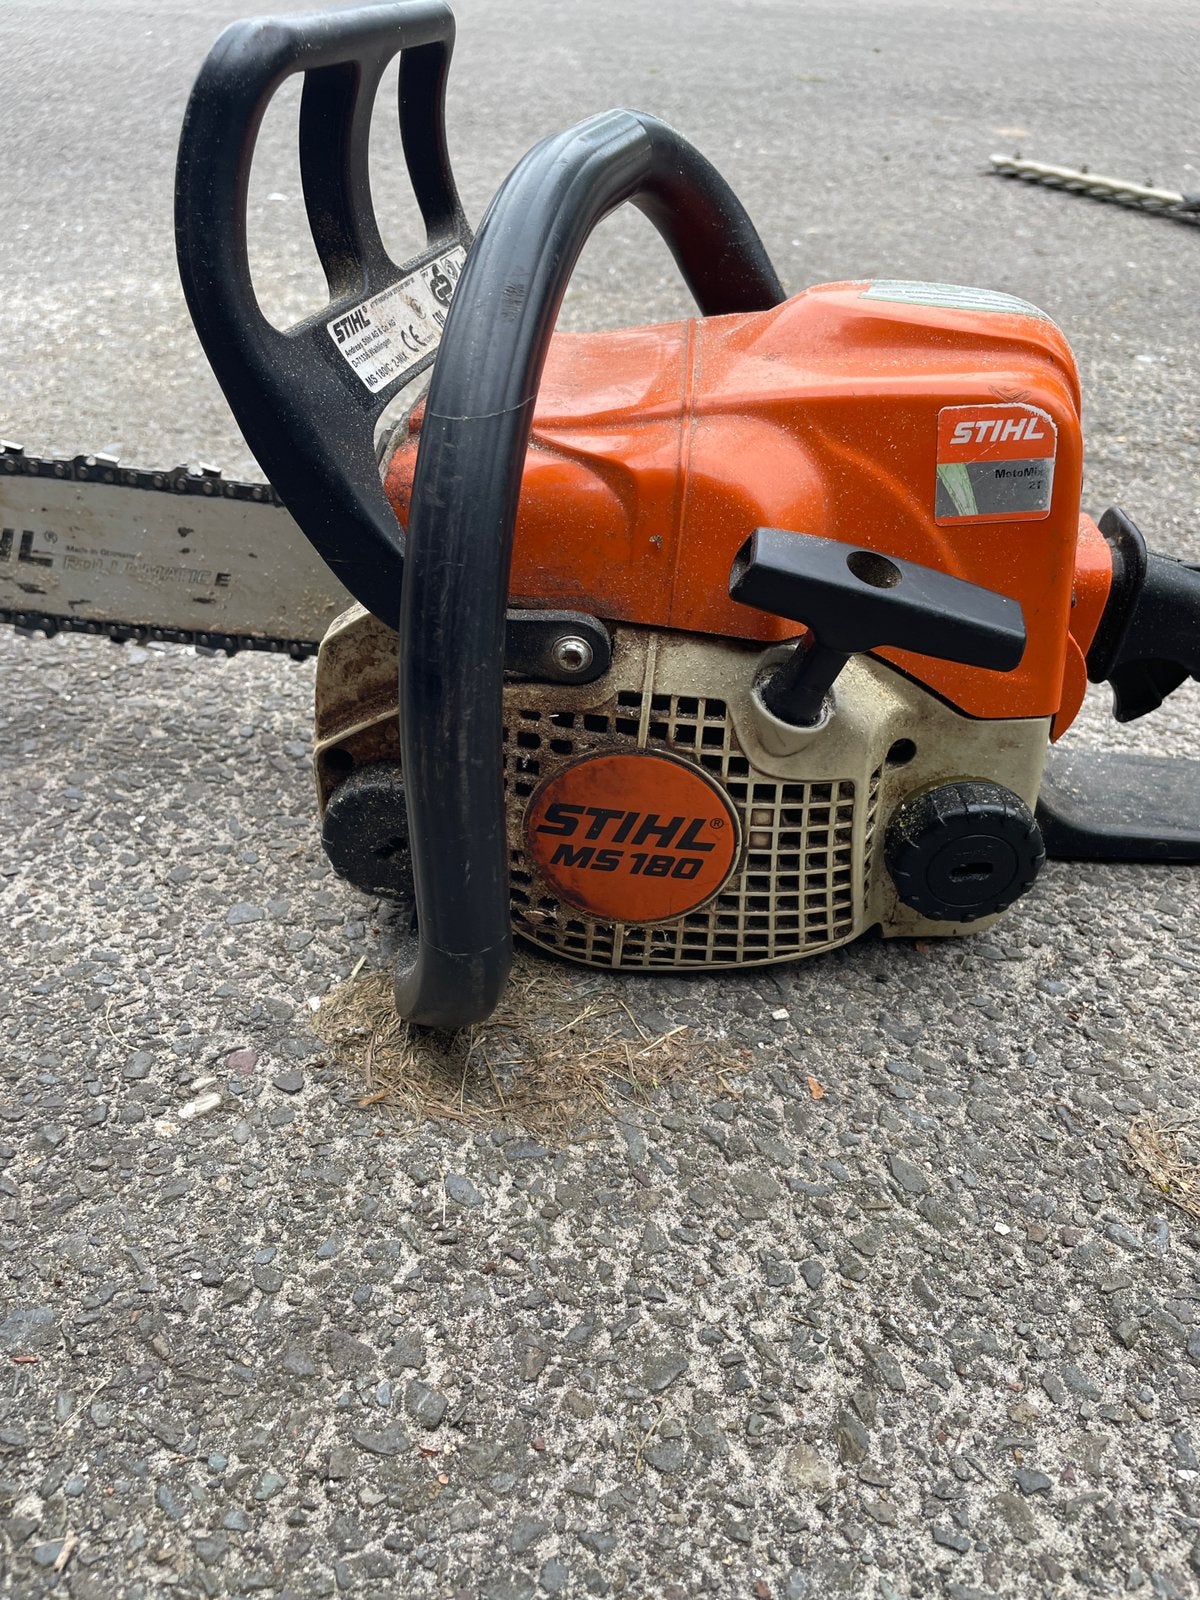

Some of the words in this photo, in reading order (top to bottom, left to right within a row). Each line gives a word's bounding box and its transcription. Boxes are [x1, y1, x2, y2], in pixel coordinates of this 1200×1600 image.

[333, 308, 371, 344] STIHL
[371, 330, 379, 339] AG
[365, 374, 378, 387] MS
[950, 418, 1045, 444] STIHL
[995, 467, 1042, 478] MotoMix
[214, 572, 231, 587] E
[536, 803, 717, 852] STIHL
[550, 844, 624, 872] MS
[630, 853, 704, 880] 180
